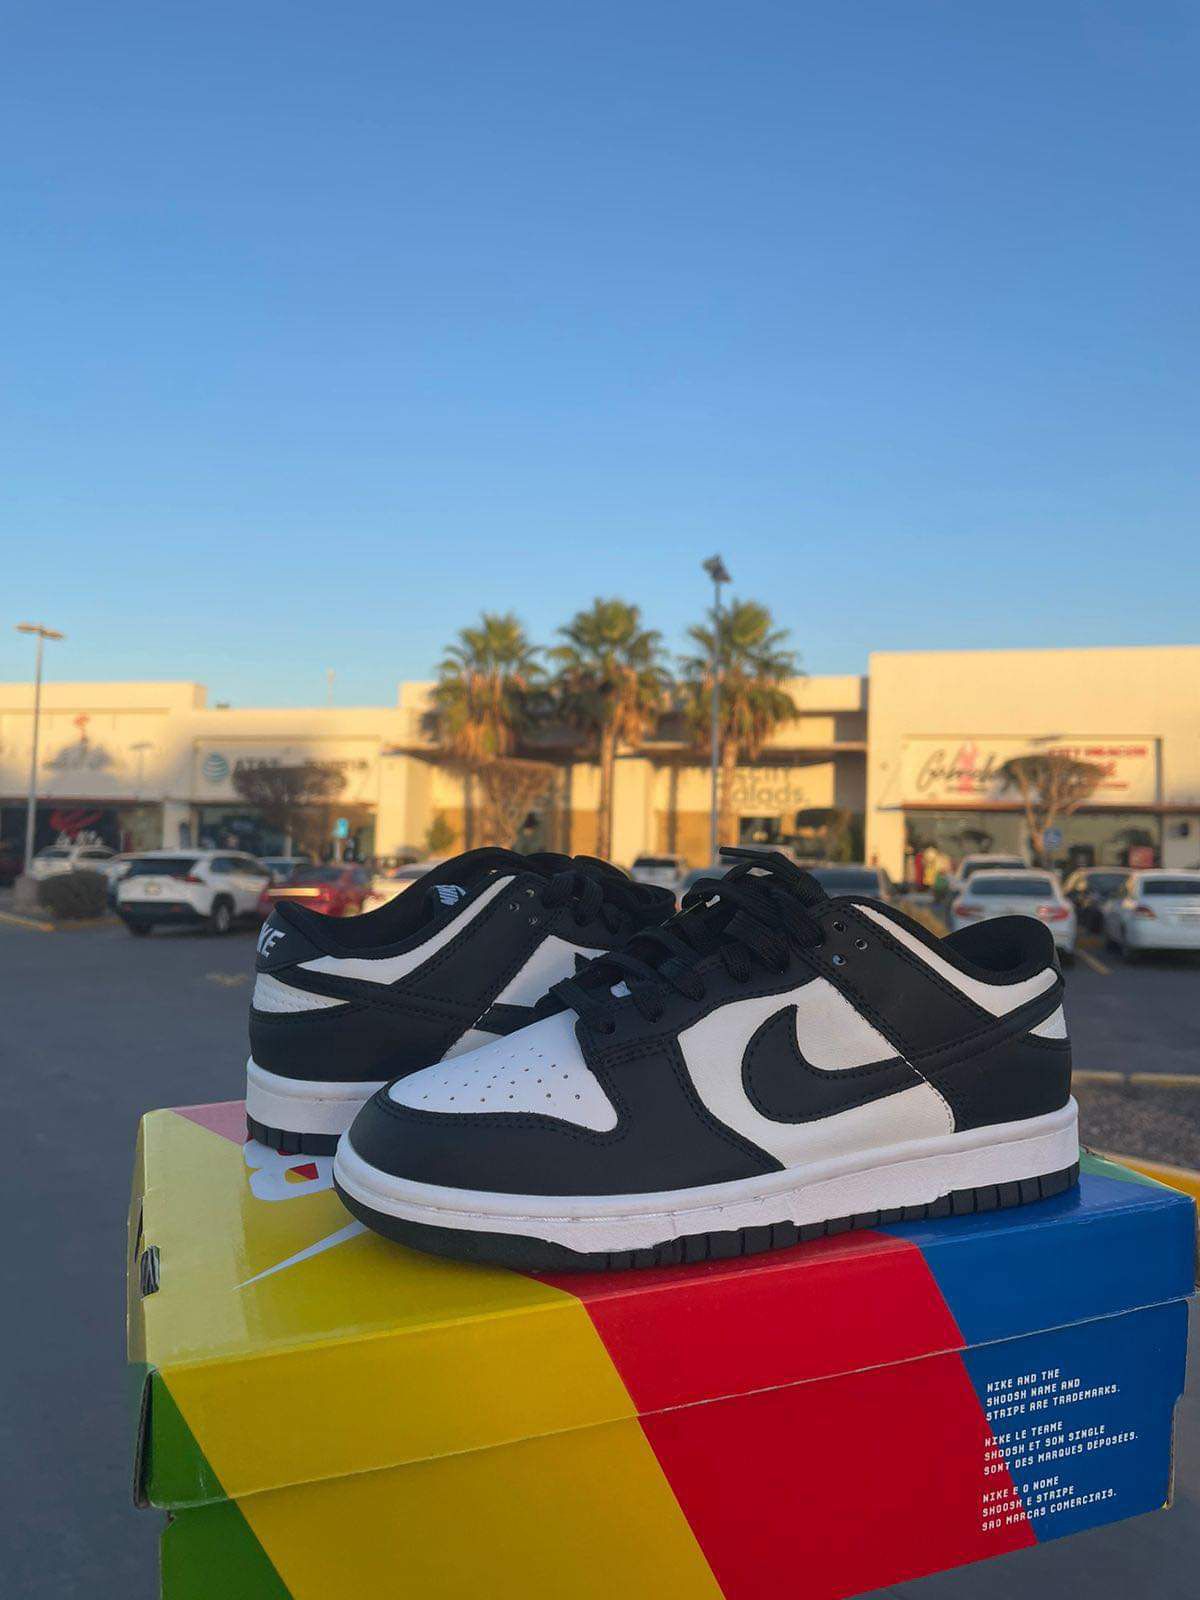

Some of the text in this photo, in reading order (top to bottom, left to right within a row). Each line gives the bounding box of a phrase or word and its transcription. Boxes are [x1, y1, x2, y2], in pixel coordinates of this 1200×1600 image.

[986, 1368, 1060, 1392] NIKE AND THE
[1031, 1383, 1057, 1397] NAME
[1061, 1378, 1080, 1390] AND
[985, 1404, 1025, 1421] STRIPE
[1029, 1399, 1049, 1411] ARE
[984, 1421, 1063, 1447] NIKE LE TERME
[1029, 1440, 1040, 1451] ET
[1045, 1434, 1064, 1447] SON
[983, 1461, 1011, 1476] SONT
[1015, 1456, 1034, 1469] DES
[1038, 1444, 1083, 1463] MARQUES
[982, 1476, 1059, 1503] NIKE E O NOME
[1026, 1496, 1033, 1506] E
[1036, 1486, 1074, 1503] STRIPE
[1005, 1507, 1046, 1525] MARCAS
